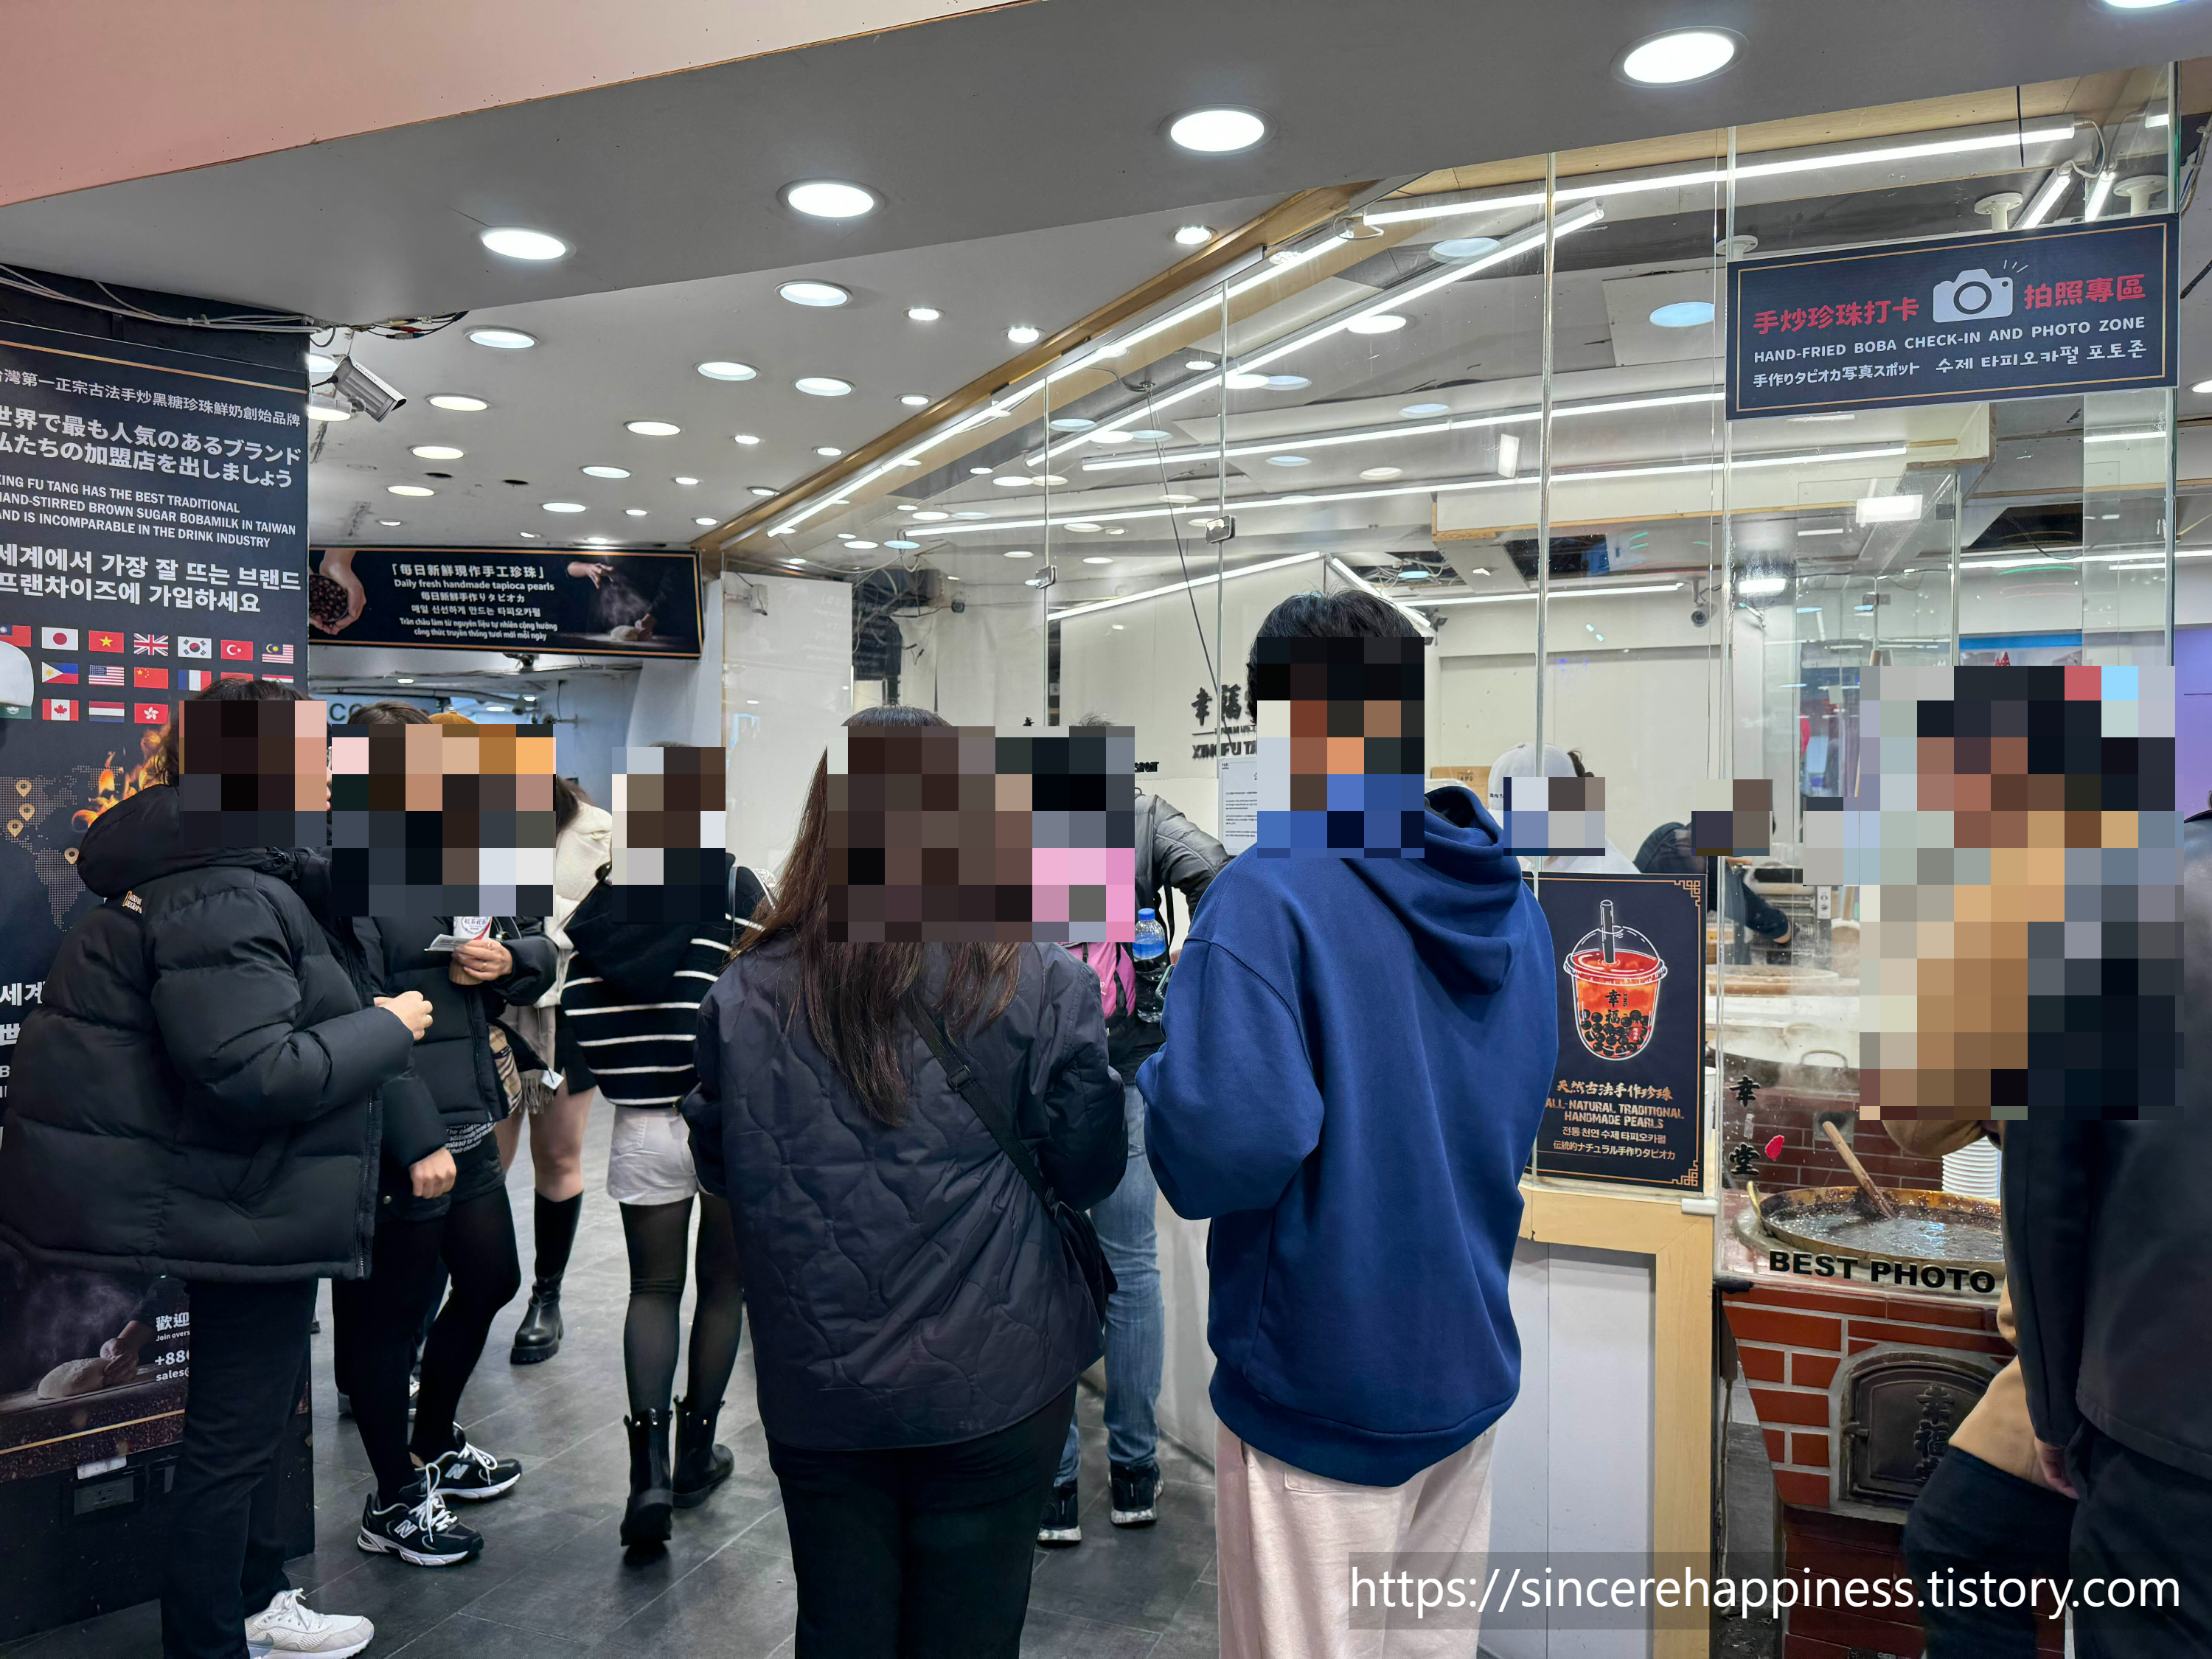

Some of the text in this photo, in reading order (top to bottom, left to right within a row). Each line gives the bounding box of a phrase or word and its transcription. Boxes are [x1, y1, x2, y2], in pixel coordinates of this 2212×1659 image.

[1753, 274, 2146, 335] 手炒珍珠打卡 拍照專區
[1753, 316, 2146, 364] HAND-FRIED BOBA CHECK-IN AND PHOTO ZONE
[1935, 339, 2147, 374] 수제 타피오카펄 포토존
[1753, 361, 1921, 389] 手作りタピオカ写真スポット
[0, 369, 301, 428] 灣第一正宗古法手炒黑糖珍珠鮮奶創始品牌
[0, 404, 302, 466] 世界で最も人気のあるブランド
[0, 475, 240, 513] ING FU TANG HAS THE BEST TRADITIONAL
[24, 512, 35, 524] IS
[39, 513, 136, 534] INCOMPARABLE
[139, 524, 150, 536] IN
[153, 526, 175, 538] THE
[178, 529, 213, 543] DRINK
[217, 533, 271, 548] INDUSTRY
[88, 502, 133, 517] BROWN
[136, 507, 176, 522] SUGAR
[179, 512, 239, 529] BOBAMILK
[242, 520, 253, 531] IN
[255, 521, 296, 535] TAIWAN
[0, 543, 302, 591] 세계에서 가장 잘 뜨는 브랜드
[0, 572, 261, 613] 프랜차이즈에 가입하세요
[394, 579, 555, 592] Daily fresh handmade tapioca pearls
[411, 605, 429, 614] 매일
[1191, 684, 1253, 727] 幸福
[1192, 743, 1217, 759] XIN
[1557, 1079, 1673, 1102] 天然古法手作珍珠
[1565, 1110, 1664, 1130] HANDMADE PEARLS
[1618, 1103, 1685, 1119] TRADITIONAL
[1553, 1140, 1676, 1161] 伝統的ナチュラル手作りタピオカ
[1562, 1126, 1666, 1144] 전통 천연 수제 타피오카펄
[1770, 1250, 1996, 1294] BEST PHOTO
[156, 1330, 190, 1342] Join overs
